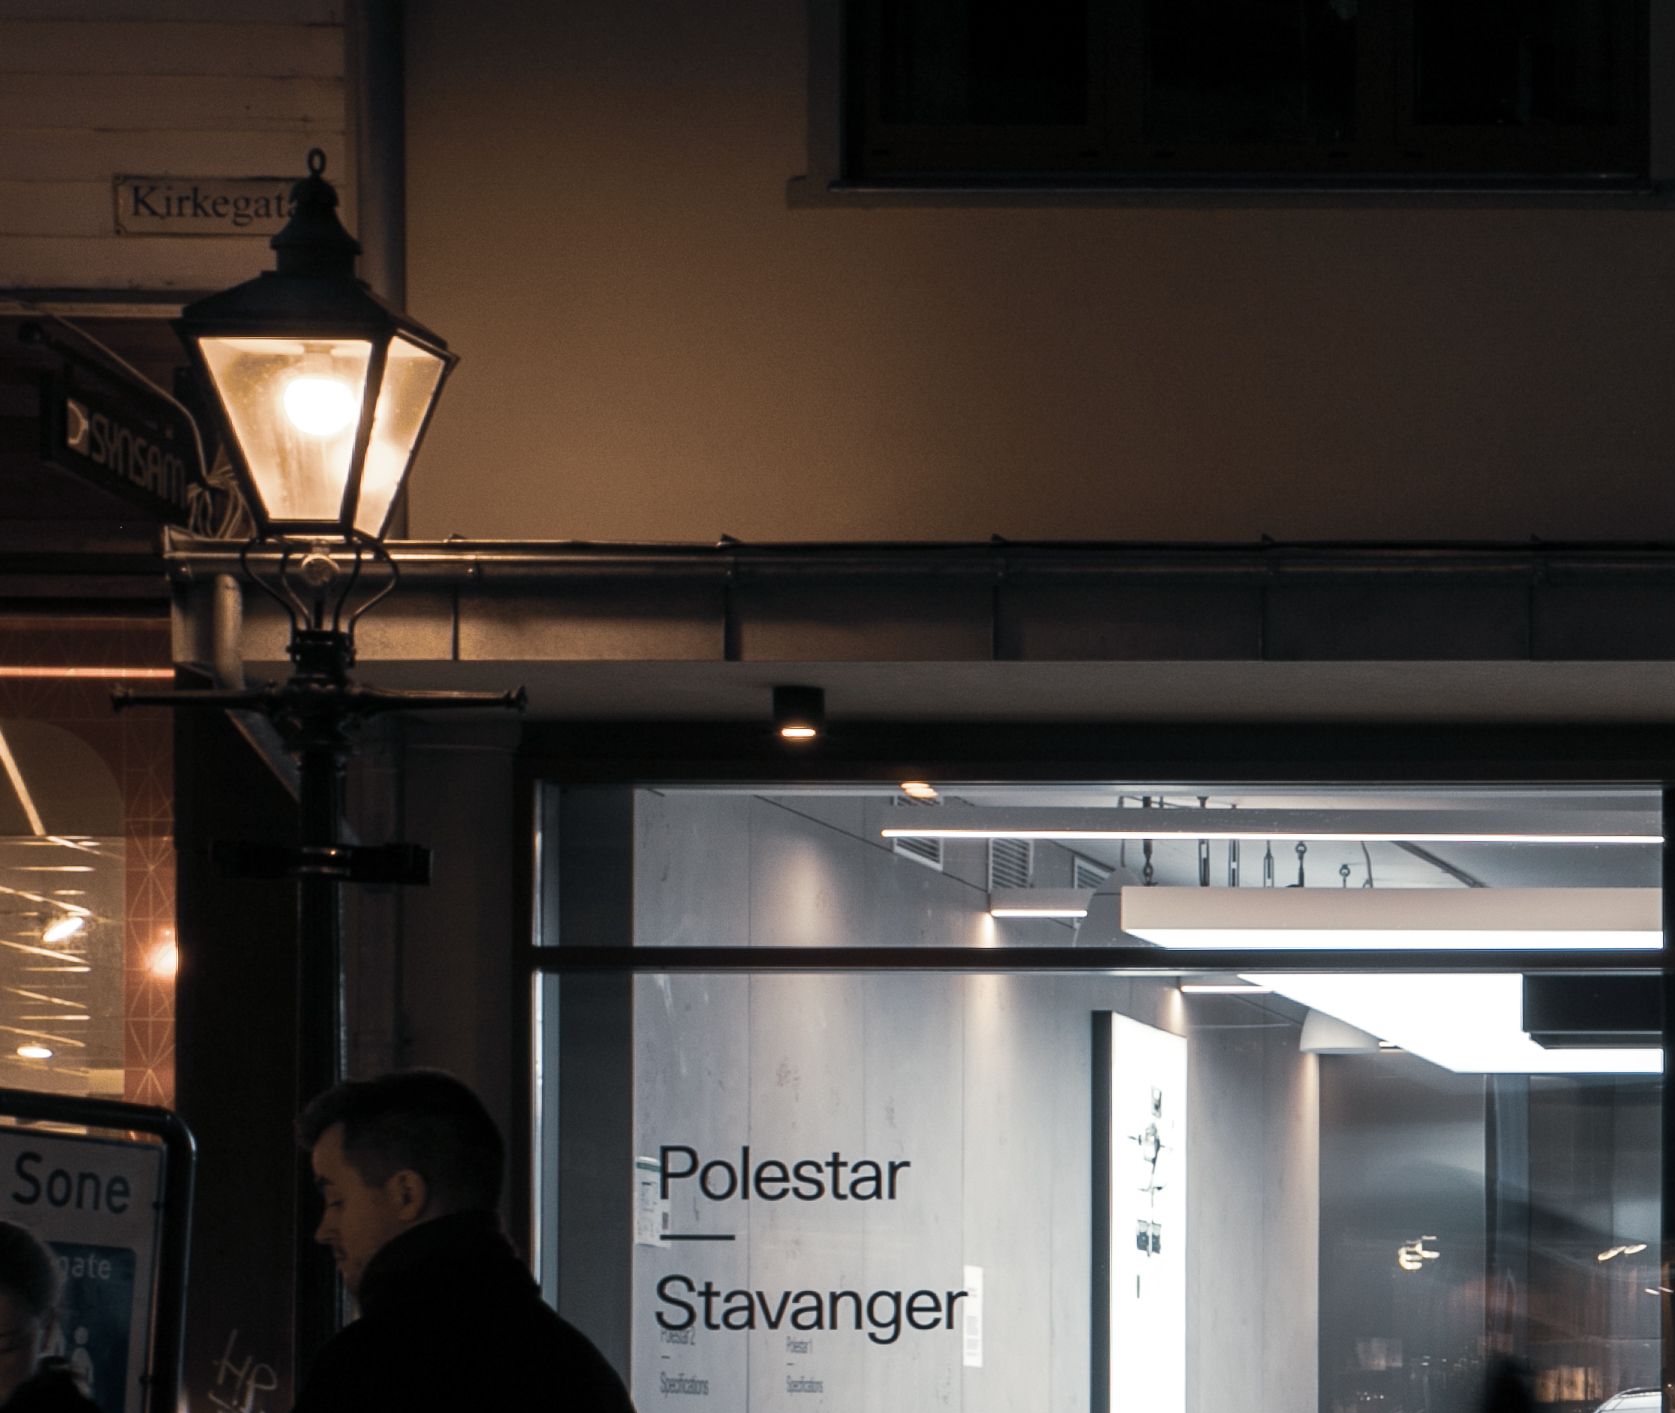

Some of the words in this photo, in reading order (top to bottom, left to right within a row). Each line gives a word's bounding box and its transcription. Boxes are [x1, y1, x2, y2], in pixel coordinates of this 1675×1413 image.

[12, 1152, 131, 1214] Sone
[659, 1145, 911, 1201] Polestar
[655, 1274, 969, 1345] Stavanger
